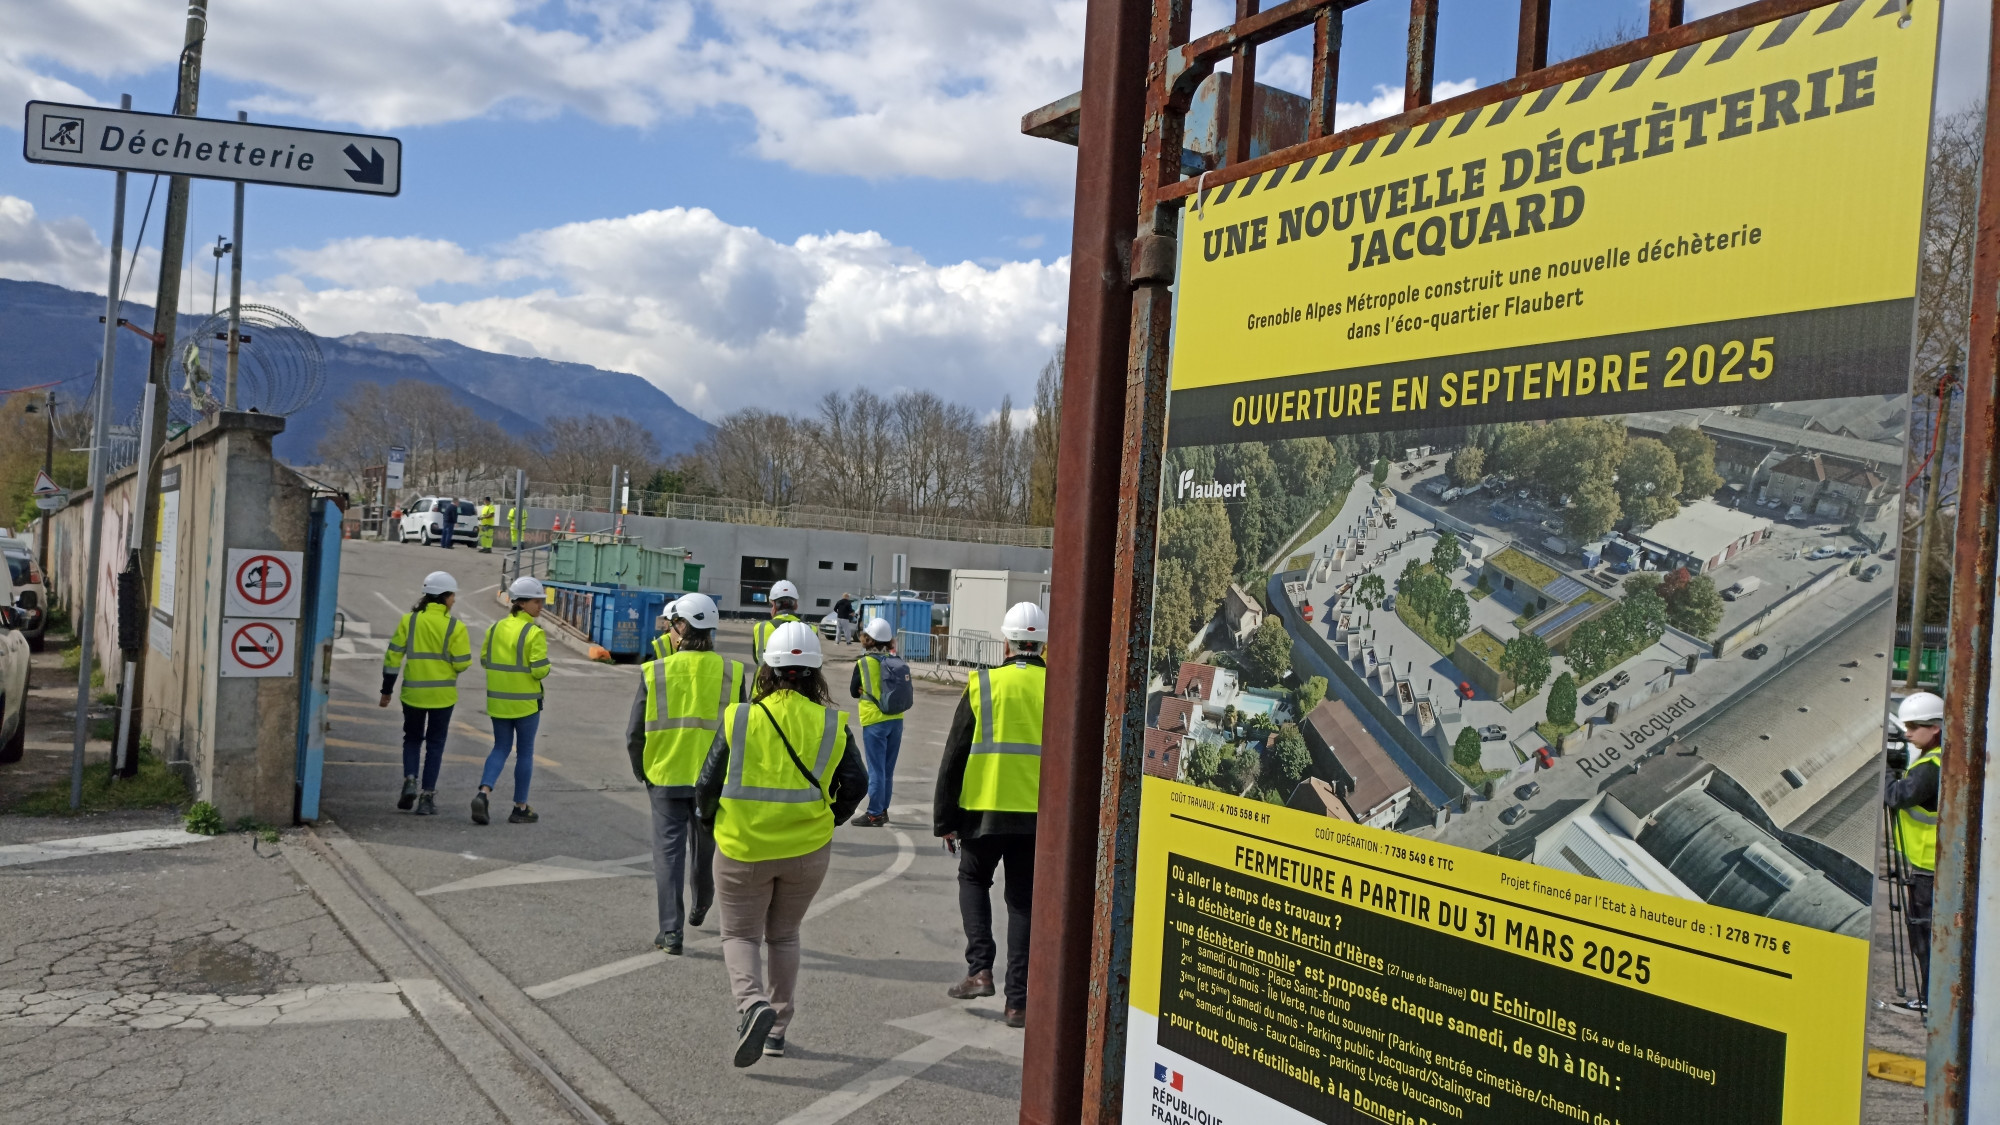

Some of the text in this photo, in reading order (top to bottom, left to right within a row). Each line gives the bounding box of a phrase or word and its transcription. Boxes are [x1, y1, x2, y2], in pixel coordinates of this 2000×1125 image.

[100, 125, 314, 171] Déchetterie
[1203, 56, 1878, 262] UNE NOUVELLE DÉCHÈTERIE
[1348, 185, 1585, 272] JACQUARD
[1248, 224, 1761, 330] Grenoble Alpes Métropole construit une nouvelle déchèterie
[1347, 322, 1380, 340] dans
[1505, 288, 1583, 316] Flaubert
[1232, 337, 1774, 426] OUVERTURE EN SEPTEMBRE 2025
[1178, 468, 1246, 499] Flaubert
[1576, 694, 1697, 778] Rue Jacquard
[1170, 792, 1187, 803] COÛT
[1188, 795, 1215, 811] TRAVAUX
[1220, 804, 1225, 813] 4
[1226, 805, 1238, 817] 705
[1239, 808, 1253, 820] 558
[1254, 812, 1259, 822] €
[1261, 813, 1270, 824] HT
[1315, 827, 1335, 843] COÛT
[1337, 832, 1379, 853] OPÉRATION
[1385, 845, 1390, 855] 7
[1391, 846, 1407, 860] 738
[1409, 851, 1426, 865] 549
[1429, 855, 1434, 866] €
[1437, 857, 1453, 871] TTC
[1172, 865, 1342, 930] Où aller le temps des travaux ?
[1235, 845, 1650, 984] FERMETURE A PARTIR DU 31 MARS 2025
[1501, 872, 1530, 890] Projet
[1533, 880, 1571, 900] financé
[1574, 893, 1592, 905] par
[1630, 904, 1636, 917] à
[1640, 906, 1687, 928] hauteur
[1691, 919, 1705, 933] de
[1717, 924, 1721, 938] 1
[1726, 927, 1749, 944] 278
[1754, 933, 1777, 951] 775
[1782, 941, 1791, 954] €
[1177, 920, 1194, 936] une
[1197, 925, 1254, 957] déchèterie
[1305, 966, 1324, 983] est
[1328, 974, 1387, 1006] proposée
[1392, 995, 1443, 1026] chaque
[1448, 1017, 1507, 1052] samedi,
[1513, 1037, 1532, 1058] de
[1538, 1045, 1558, 1068] 9h
[1564, 1053, 1573, 1074] à
[1579, 1058, 1609, 1087] 16h
[1178, 889, 1184, 903] à
[1187, 891, 1195, 907] la
[1198, 896, 1255, 927] déchèterie
[1259, 916, 1272, 933] de
[1275, 921, 1288, 938] St
[1292, 926, 1331, 953] Martin
[1387, 963, 1400, 976] (27
[1401, 970, 1414, 981] rue
[1417, 974, 1426, 985] de
[1429, 977, 1466, 1001] Barnave)
[1470, 989, 1488, 1006] ou
[1494, 992, 1576, 1035] Echirolles
[1582, 1028, 1598, 1043] (54
[1602, 1037, 1614, 1048] av
[1618, 1040, 1630, 1054] de
[1634, 1044, 1643, 1058] la
[1647, 1049, 1715, 1085] République)
[1182, 937, 1190, 949] 1er
[1198, 946, 1226, 964] samedi
[1228, 956, 1238, 969] du
[1240, 962, 1259, 977] mois
[1268, 970, 1291, 989] Place
[1294, 979, 1350, 1011] Saint-Bruno
[1171, 1013, 1193, 1031] pour
[1196, 1021, 1218, 1043] tout
[1222, 1034, 1250, 1057] objet
[1253, 1048, 1323, 1093] réutilisable,
[1328, 1077, 1335, 1095] à
[1339, 1082, 1350, 1102] la
[1181, 953, 1192, 965] 2nd
[1197, 962, 1225, 980] samedi
[1227, 972, 1237, 985] du
[1239, 978, 1259, 993] mois
[1268, 982, 1278, 1001] Île
[1281, 991, 1307, 1014] Verte,
[1310, 1005, 1325, 1019] rue
[1328, 1010, 1339, 1025] du
[1342, 1018, 1385, 1042] souvenir
[1388, 1033, 1432, 1064] (Parking
[1435, 1054, 1472, 1077] entrée
[1594, 1113, 1610, 1125] de
[1196, 998, 1223, 1017] samedi
[1226, 1009, 1235, 1023] du
[1238, 1016, 1257, 1032] mois
[1266, 1025, 1287, 1044] Eaux
[1290, 1035, 1320, 1058] Claires
[1330, 1054, 1366, 1081] parking
[1369, 1067, 1398, 1091] Lycée
[1402, 1081, 1462, 1119] Vaucanson
[1197, 978, 1209, 992] (et
[1232, 995, 1262, 1014] samedi
[1264, 1005, 1274, 1019] du
[1277, 1012, 1298, 1029] mois
[1307, 1021, 1342, 1050] Parking
[1344, 1040, 1374, 1060] public
